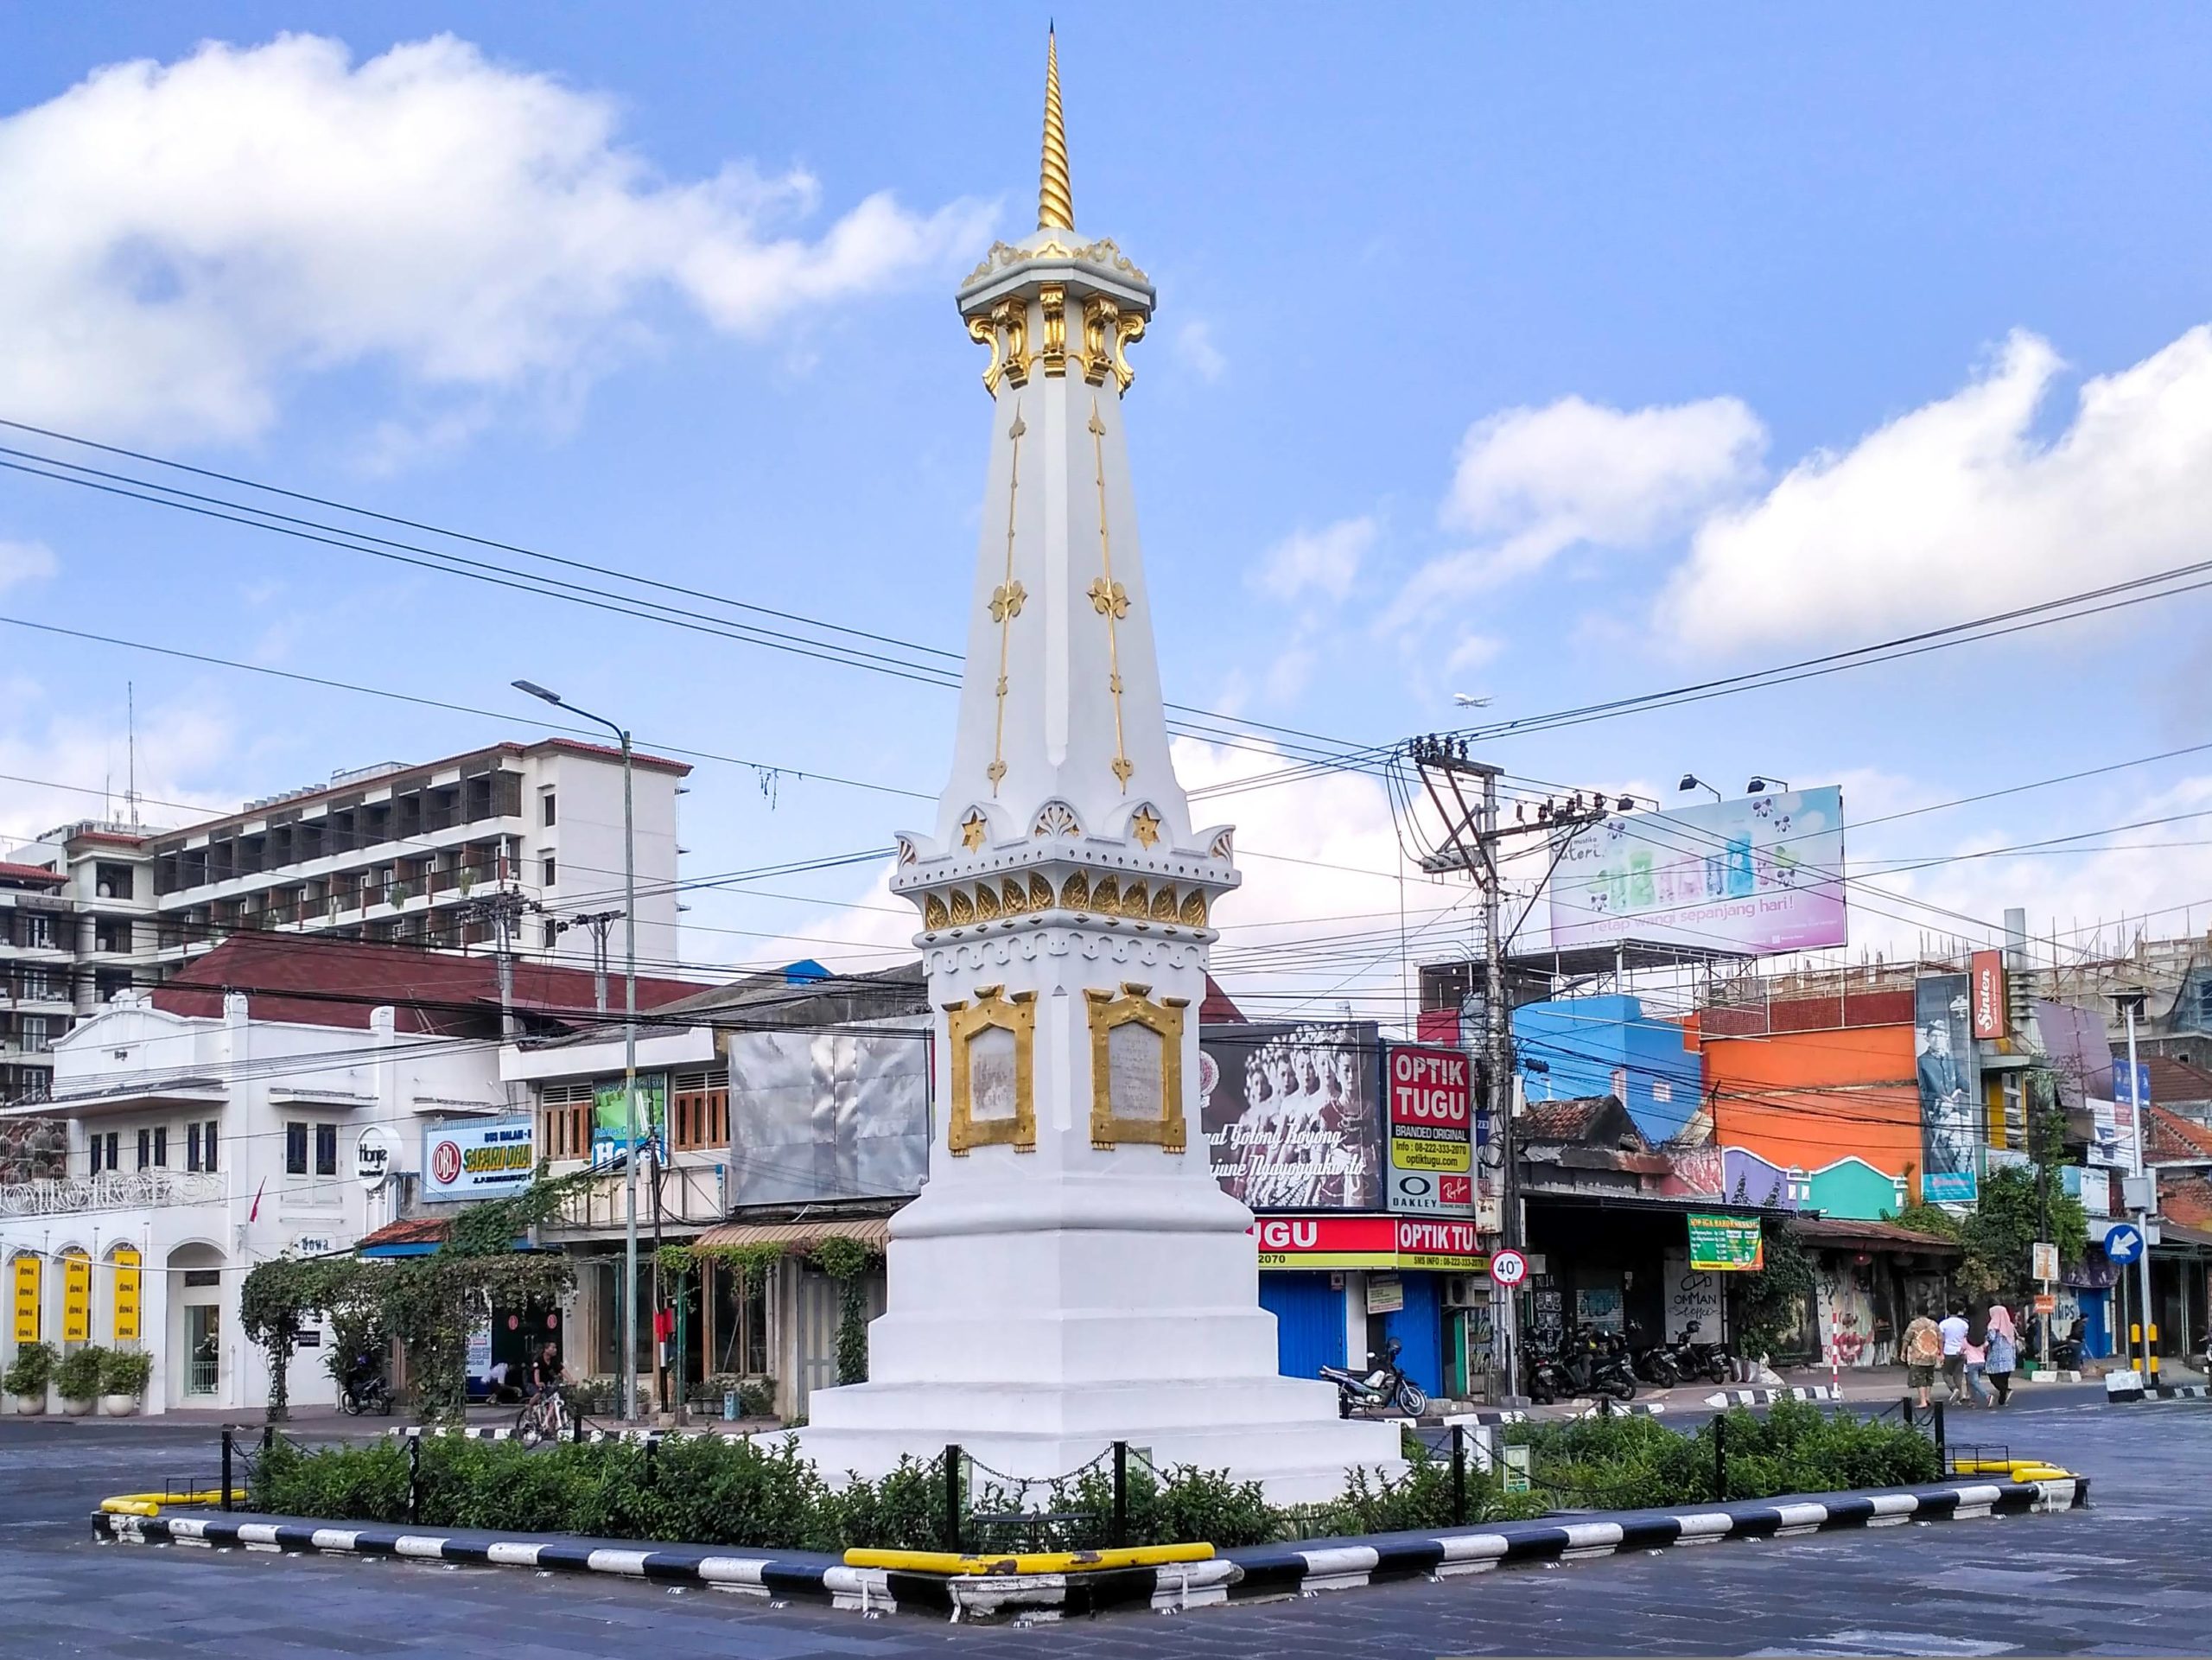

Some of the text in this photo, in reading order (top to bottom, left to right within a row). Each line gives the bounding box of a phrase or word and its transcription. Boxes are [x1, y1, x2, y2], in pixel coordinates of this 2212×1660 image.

[1635, 912, 1676, 927] wangi
[1681, 900, 1756, 924] sepanjang
[1395, 1054, 1465, 1086] OPTIK
[1395, 1086, 1465, 1120] TUGU
[1395, 1124, 1467, 1142] BRANDED ORIGINAL
[463, 1144, 532, 1173] SAFARI DHA
[1395, 1141, 1409, 1152] Info
[1414, 1142, 1466, 1155] 08-222-333-2070
[435, 1145, 456, 1179] OBL
[1406, 1154, 1459, 1167] optiktugu.com
[1393, 1198, 1437, 1208] OAKLEY
[1400, 1223, 1449, 1250] OPTIK
[1414, 1256, 1425, 1265] SMS
[1426, 1256, 1440, 1266] INFO
[1497, 1261, 1515, 1275] 40
